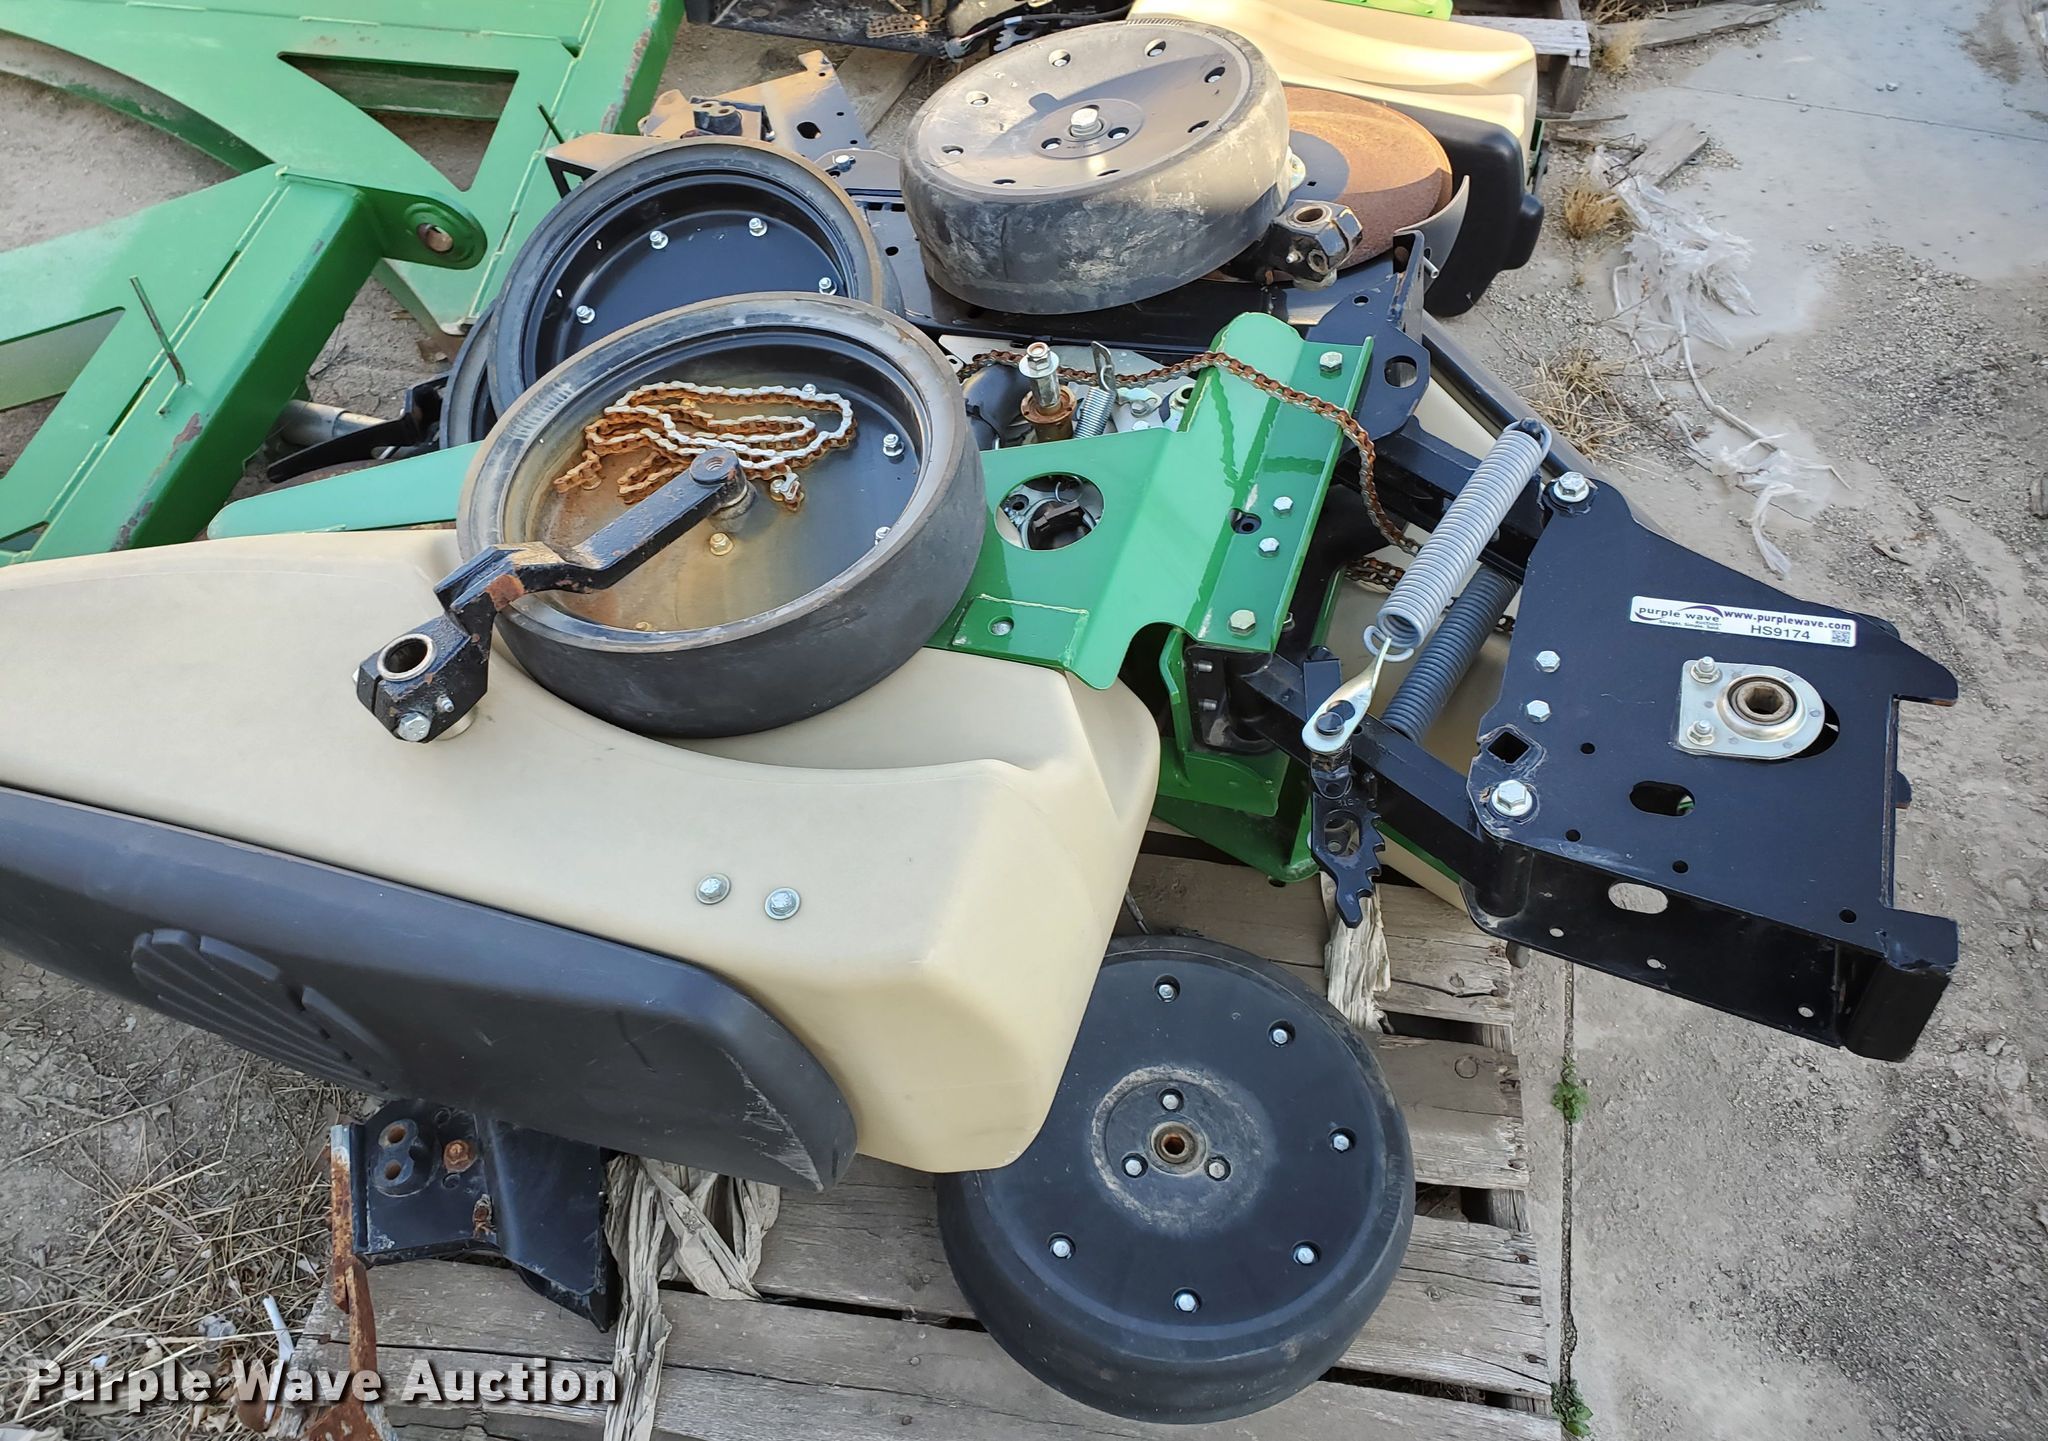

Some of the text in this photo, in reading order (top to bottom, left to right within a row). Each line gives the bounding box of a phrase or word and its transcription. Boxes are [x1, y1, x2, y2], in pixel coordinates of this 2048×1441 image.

[1638, 607, 1720, 622] purple wave
[1724, 610, 1851, 630] www.purplewave.com
[1751, 625, 1810, 640] HS9174
